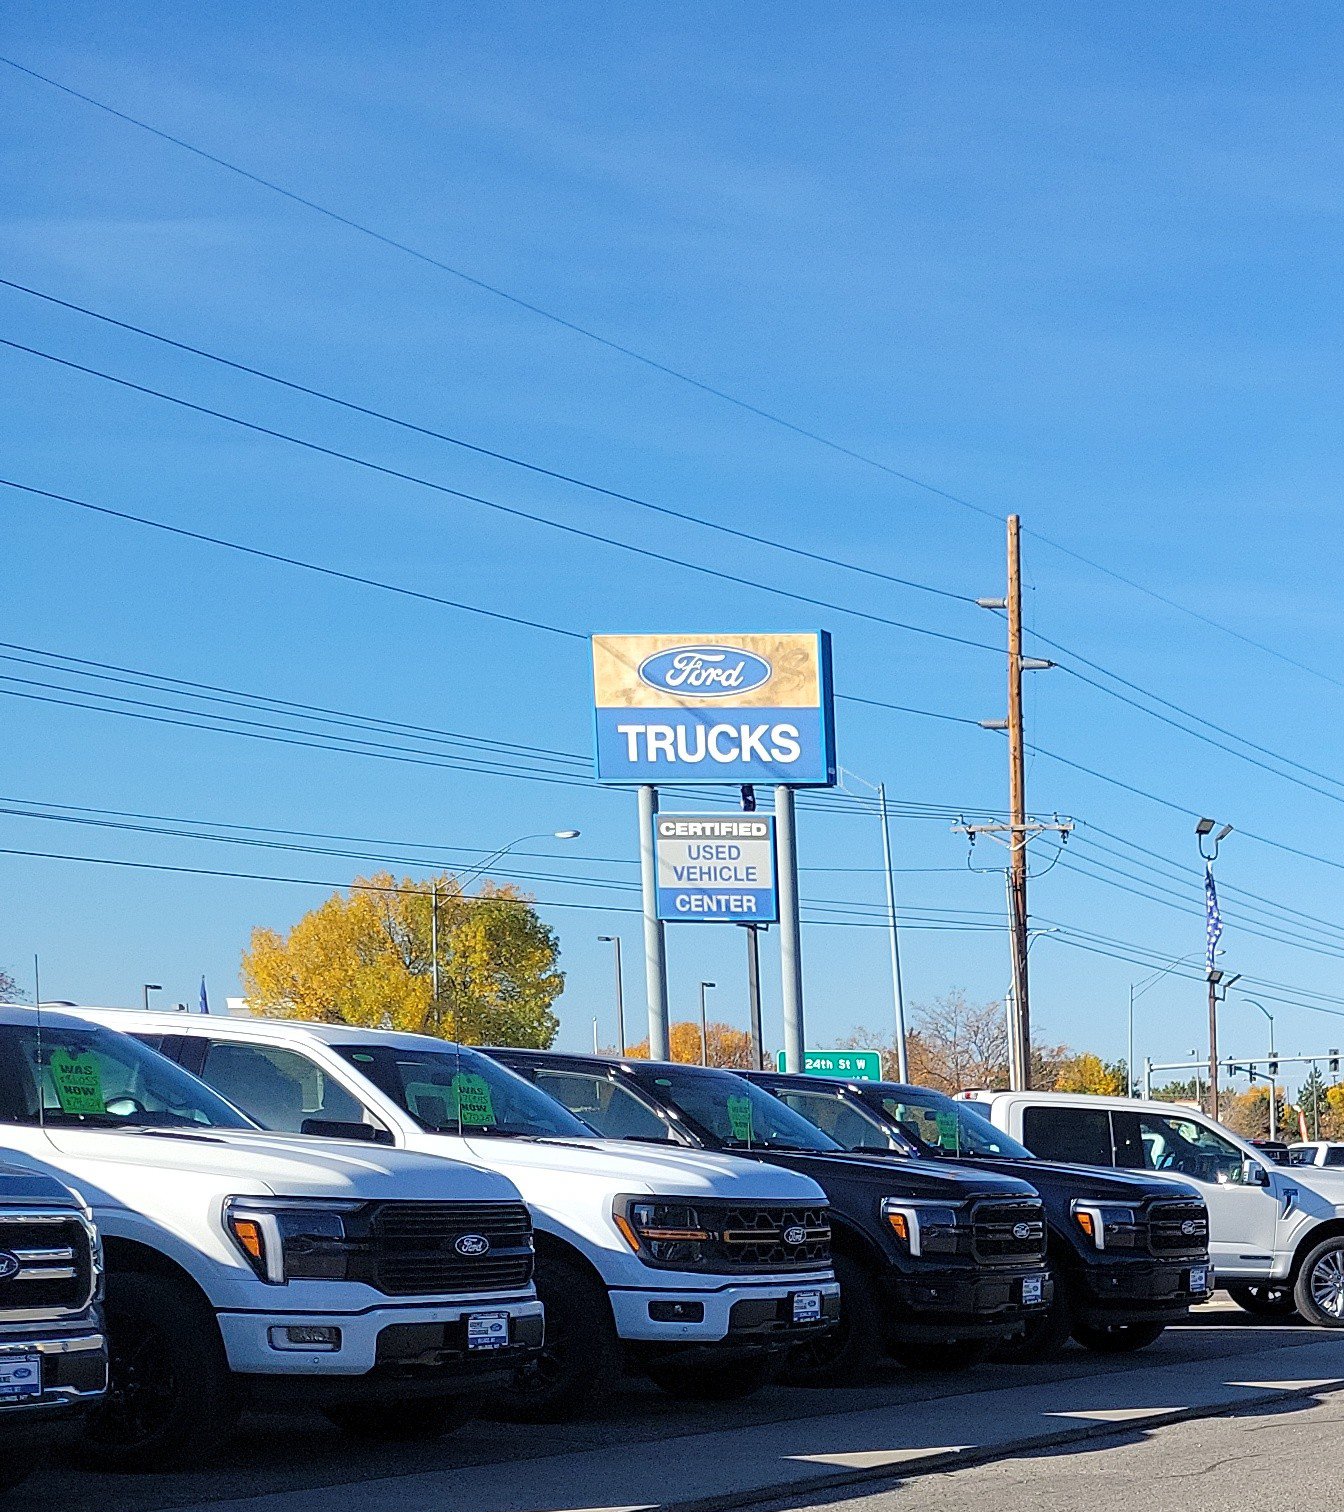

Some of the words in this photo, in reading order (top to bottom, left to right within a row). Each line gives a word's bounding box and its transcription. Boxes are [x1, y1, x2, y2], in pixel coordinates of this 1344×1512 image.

[666, 652, 744, 687] Ford
[617, 724, 801, 763] TRUCKS
[659, 821, 768, 837] CERTIFIED
[687, 844, 741, 861] USED
[672, 865, 758, 882] VEHICLE
[675, 894, 757, 912] CENTER
[805, 1058, 833, 1069] 24th
[838, 1058, 851, 1069] St
[856, 1058, 866, 1069] W
[461, 1238, 483, 1252] Ford
